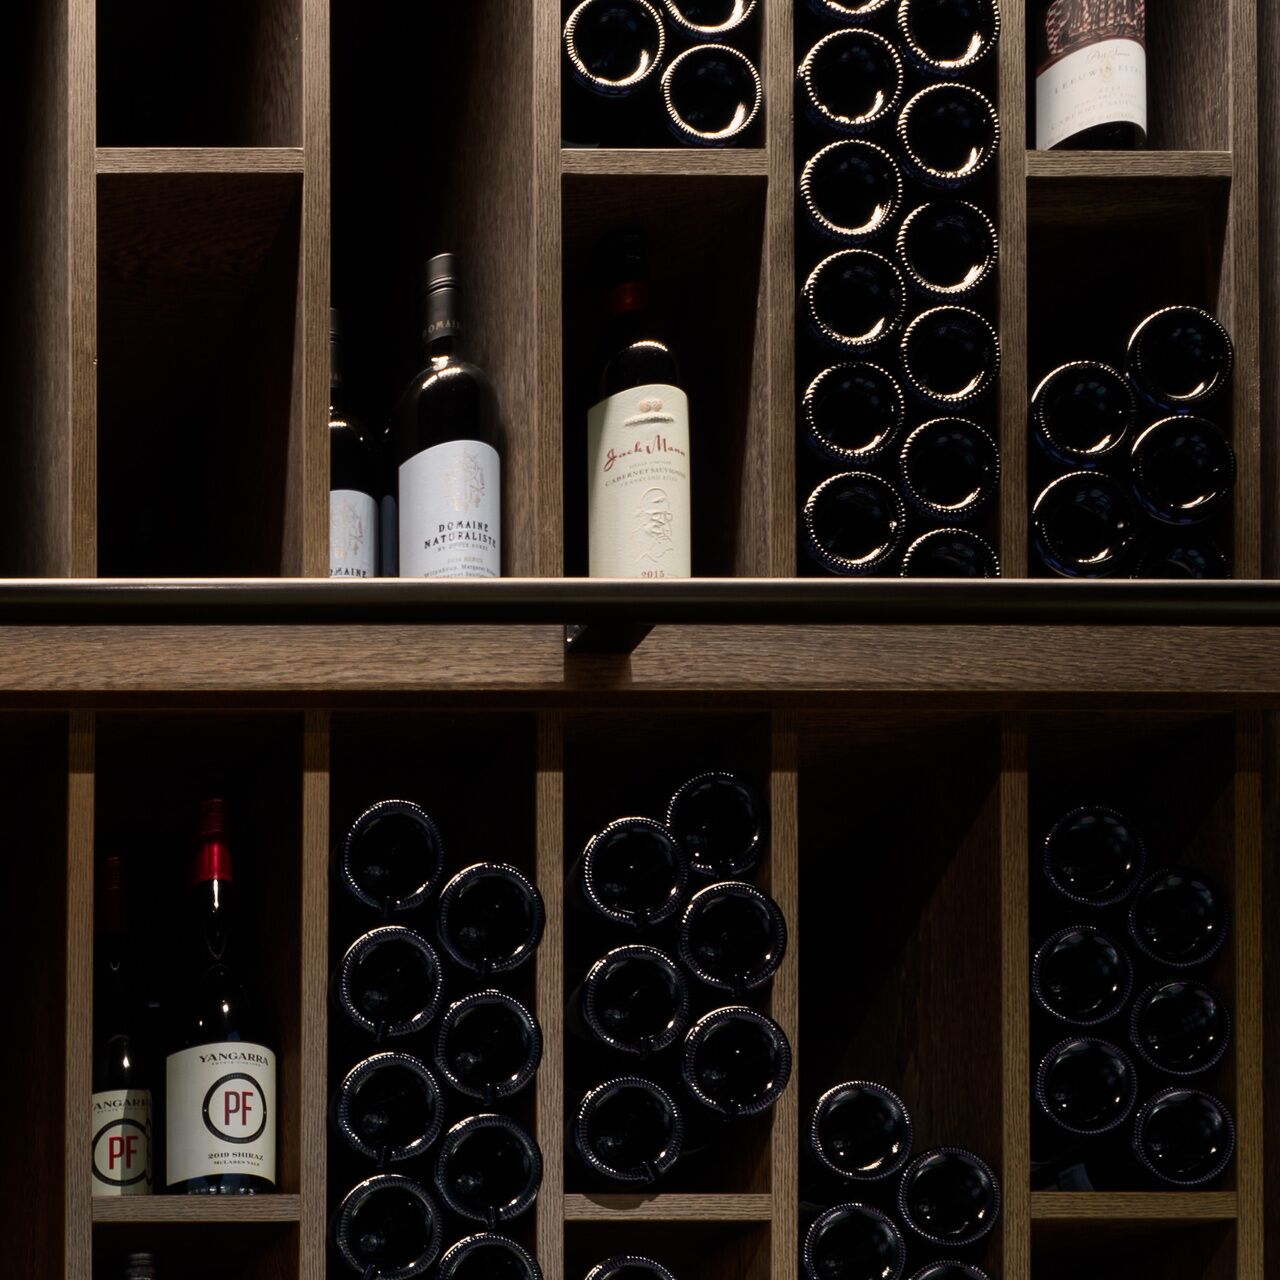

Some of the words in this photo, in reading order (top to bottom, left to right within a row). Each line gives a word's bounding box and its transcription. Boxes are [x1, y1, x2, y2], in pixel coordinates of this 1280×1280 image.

[603, 441, 643, 472] Jack
[646, 434, 686, 457] Mann
[439, 521, 488, 532] DOMAINE
[425, 532, 496, 549] NATURALISTE
[199, 1052, 269, 1066] YANGARRA
[224, 1091, 253, 1126] PF
[109, 1136, 139, 1169] PF
[232, 1152, 264, 1160] SHIRAZ
